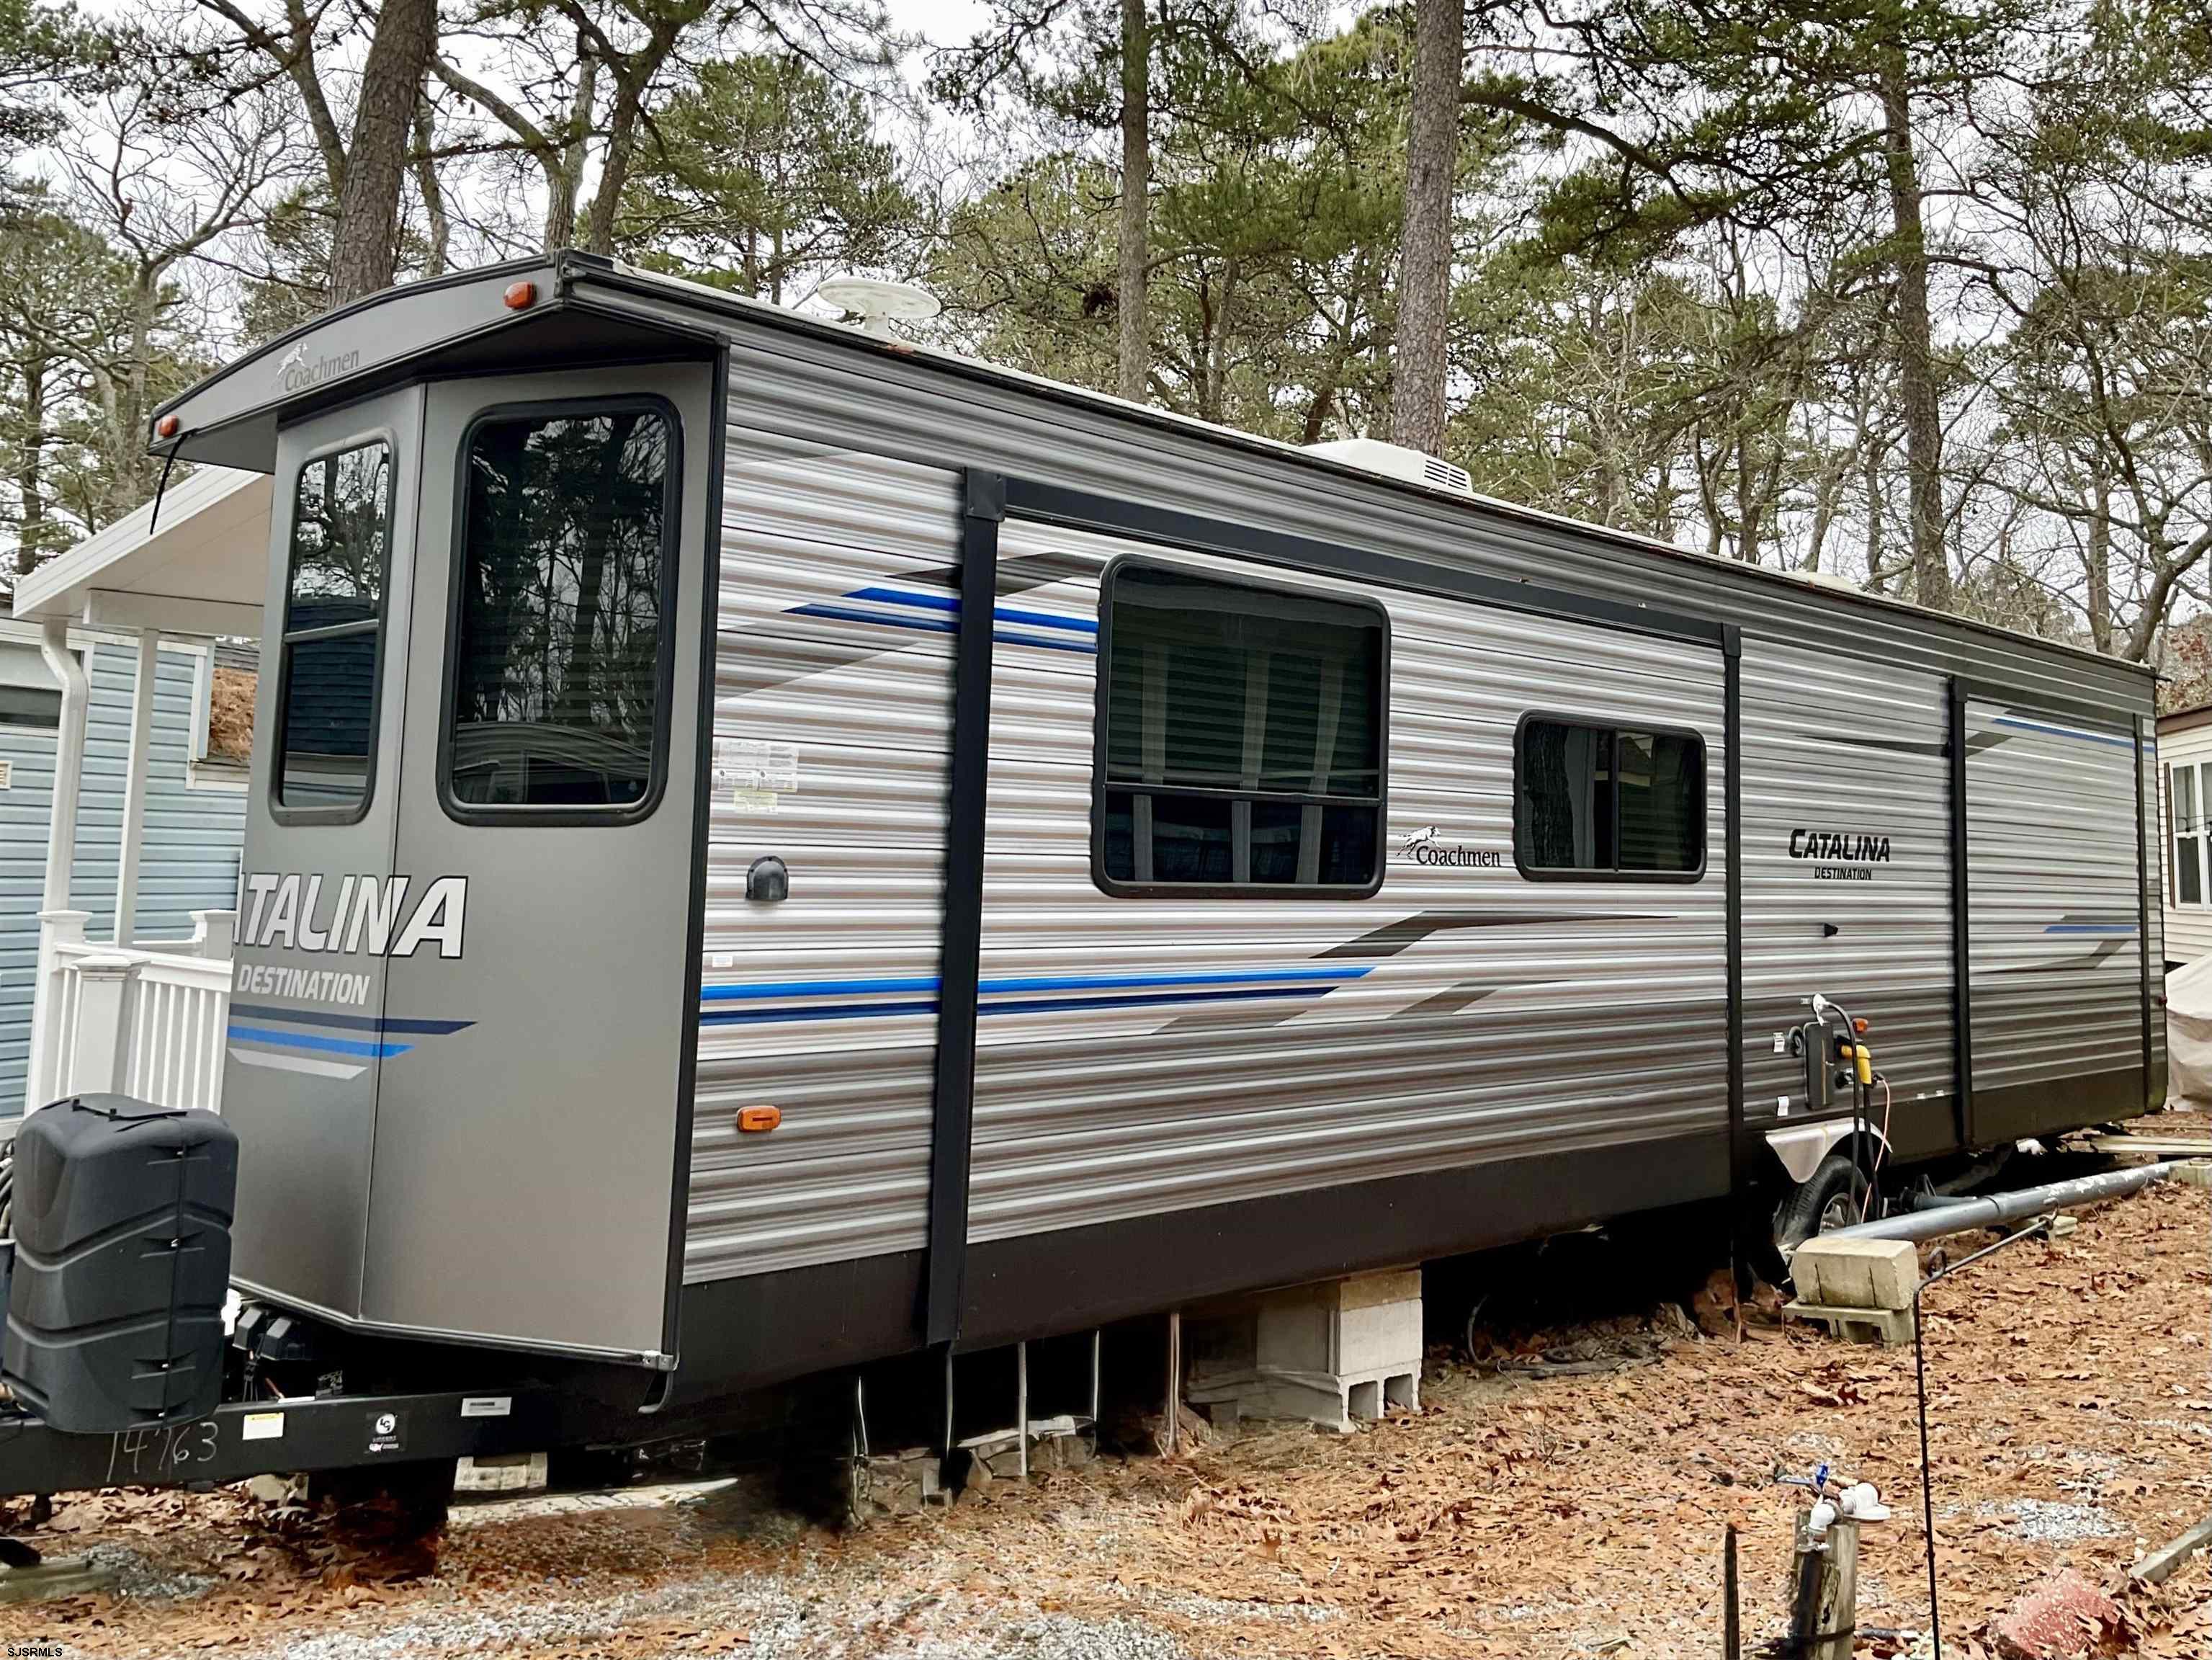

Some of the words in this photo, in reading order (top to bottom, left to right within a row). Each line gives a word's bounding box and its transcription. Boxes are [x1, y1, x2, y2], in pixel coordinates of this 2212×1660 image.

[285, 349, 359, 392] Coachmen
[1416, 845, 1501, 866] Coachmen
[1788, 829, 1890, 862] CATALINA
[1814, 867, 1872, 880] DESTINATION
[236, 964, 370, 1005] DESTINATION
[107, 1422, 218, 1483] 14763
